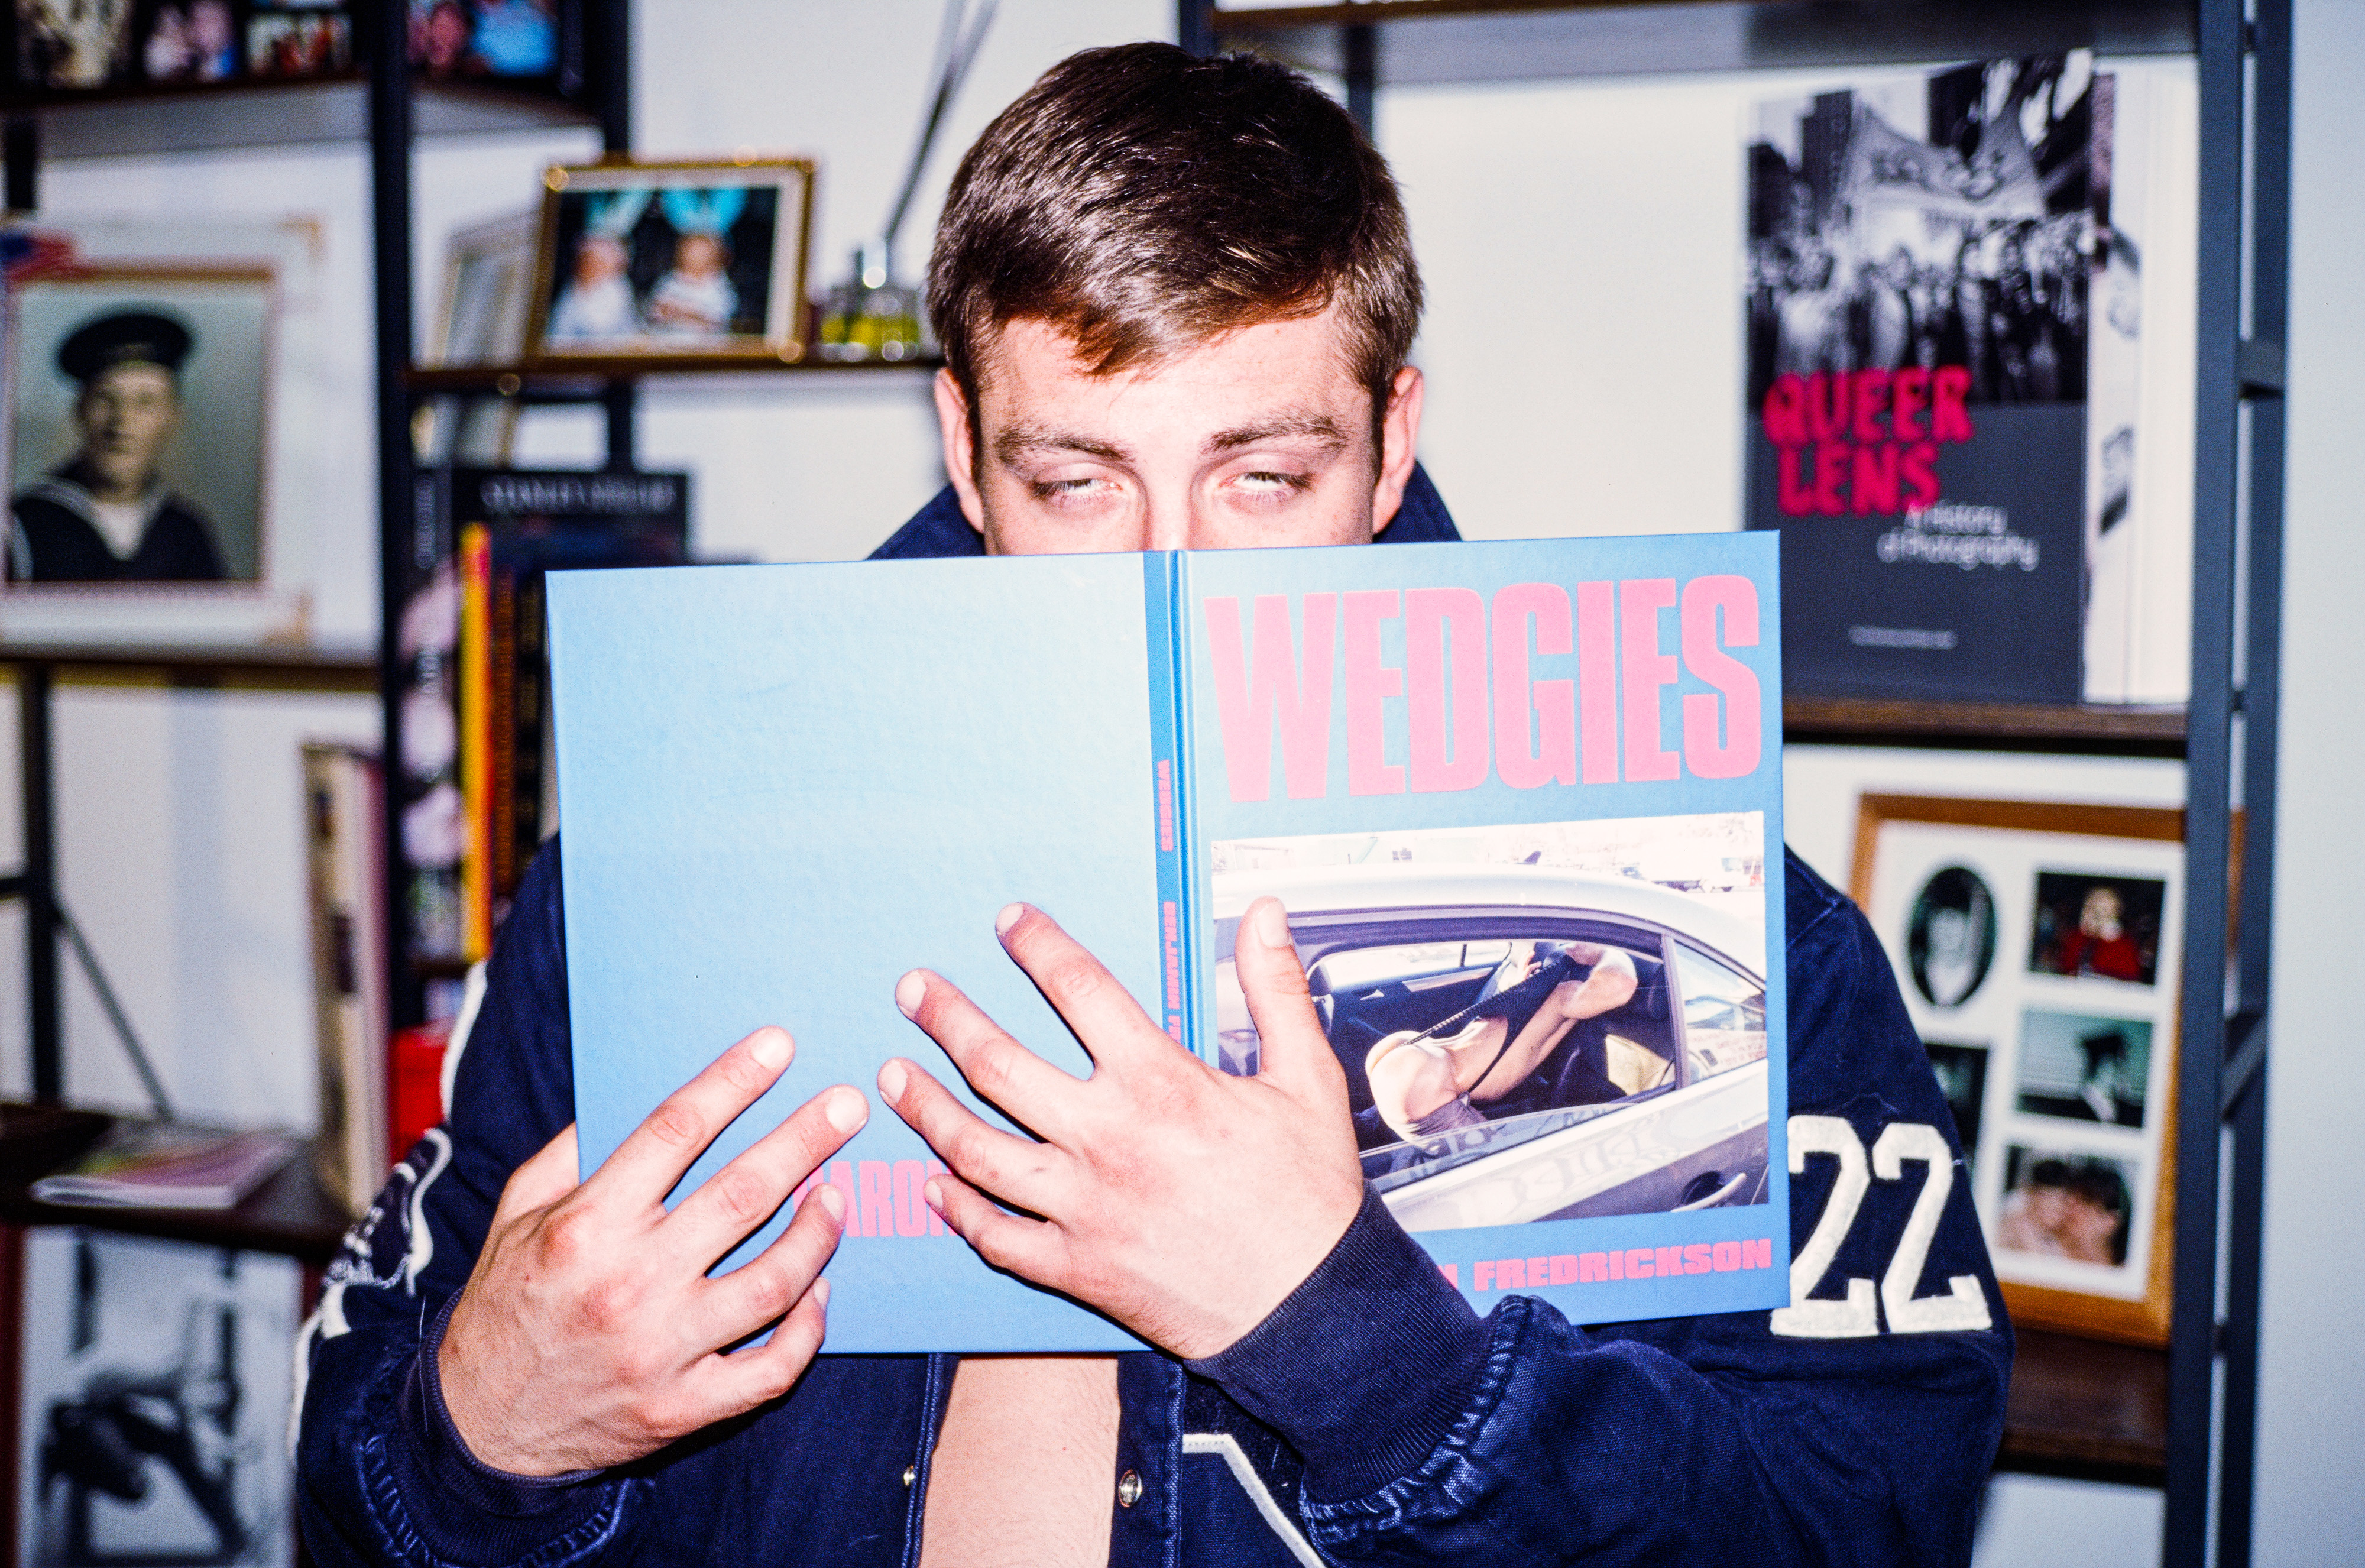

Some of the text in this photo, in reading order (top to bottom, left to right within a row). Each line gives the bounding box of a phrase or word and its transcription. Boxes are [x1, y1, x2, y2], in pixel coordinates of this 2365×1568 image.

[1763, 365, 1974, 445] QUEER
[1777, 441, 1940, 517] LENS
[1203, 575, 1761, 802] WEDGIES
[1157, 759, 1174, 852] WEDGIES
[1163, 901, 1181, 1010] BENJAMIN
[1473, 1238, 1772, 1291] FREDRICKSON
[1770, 1115, 1992, 1339] 22
